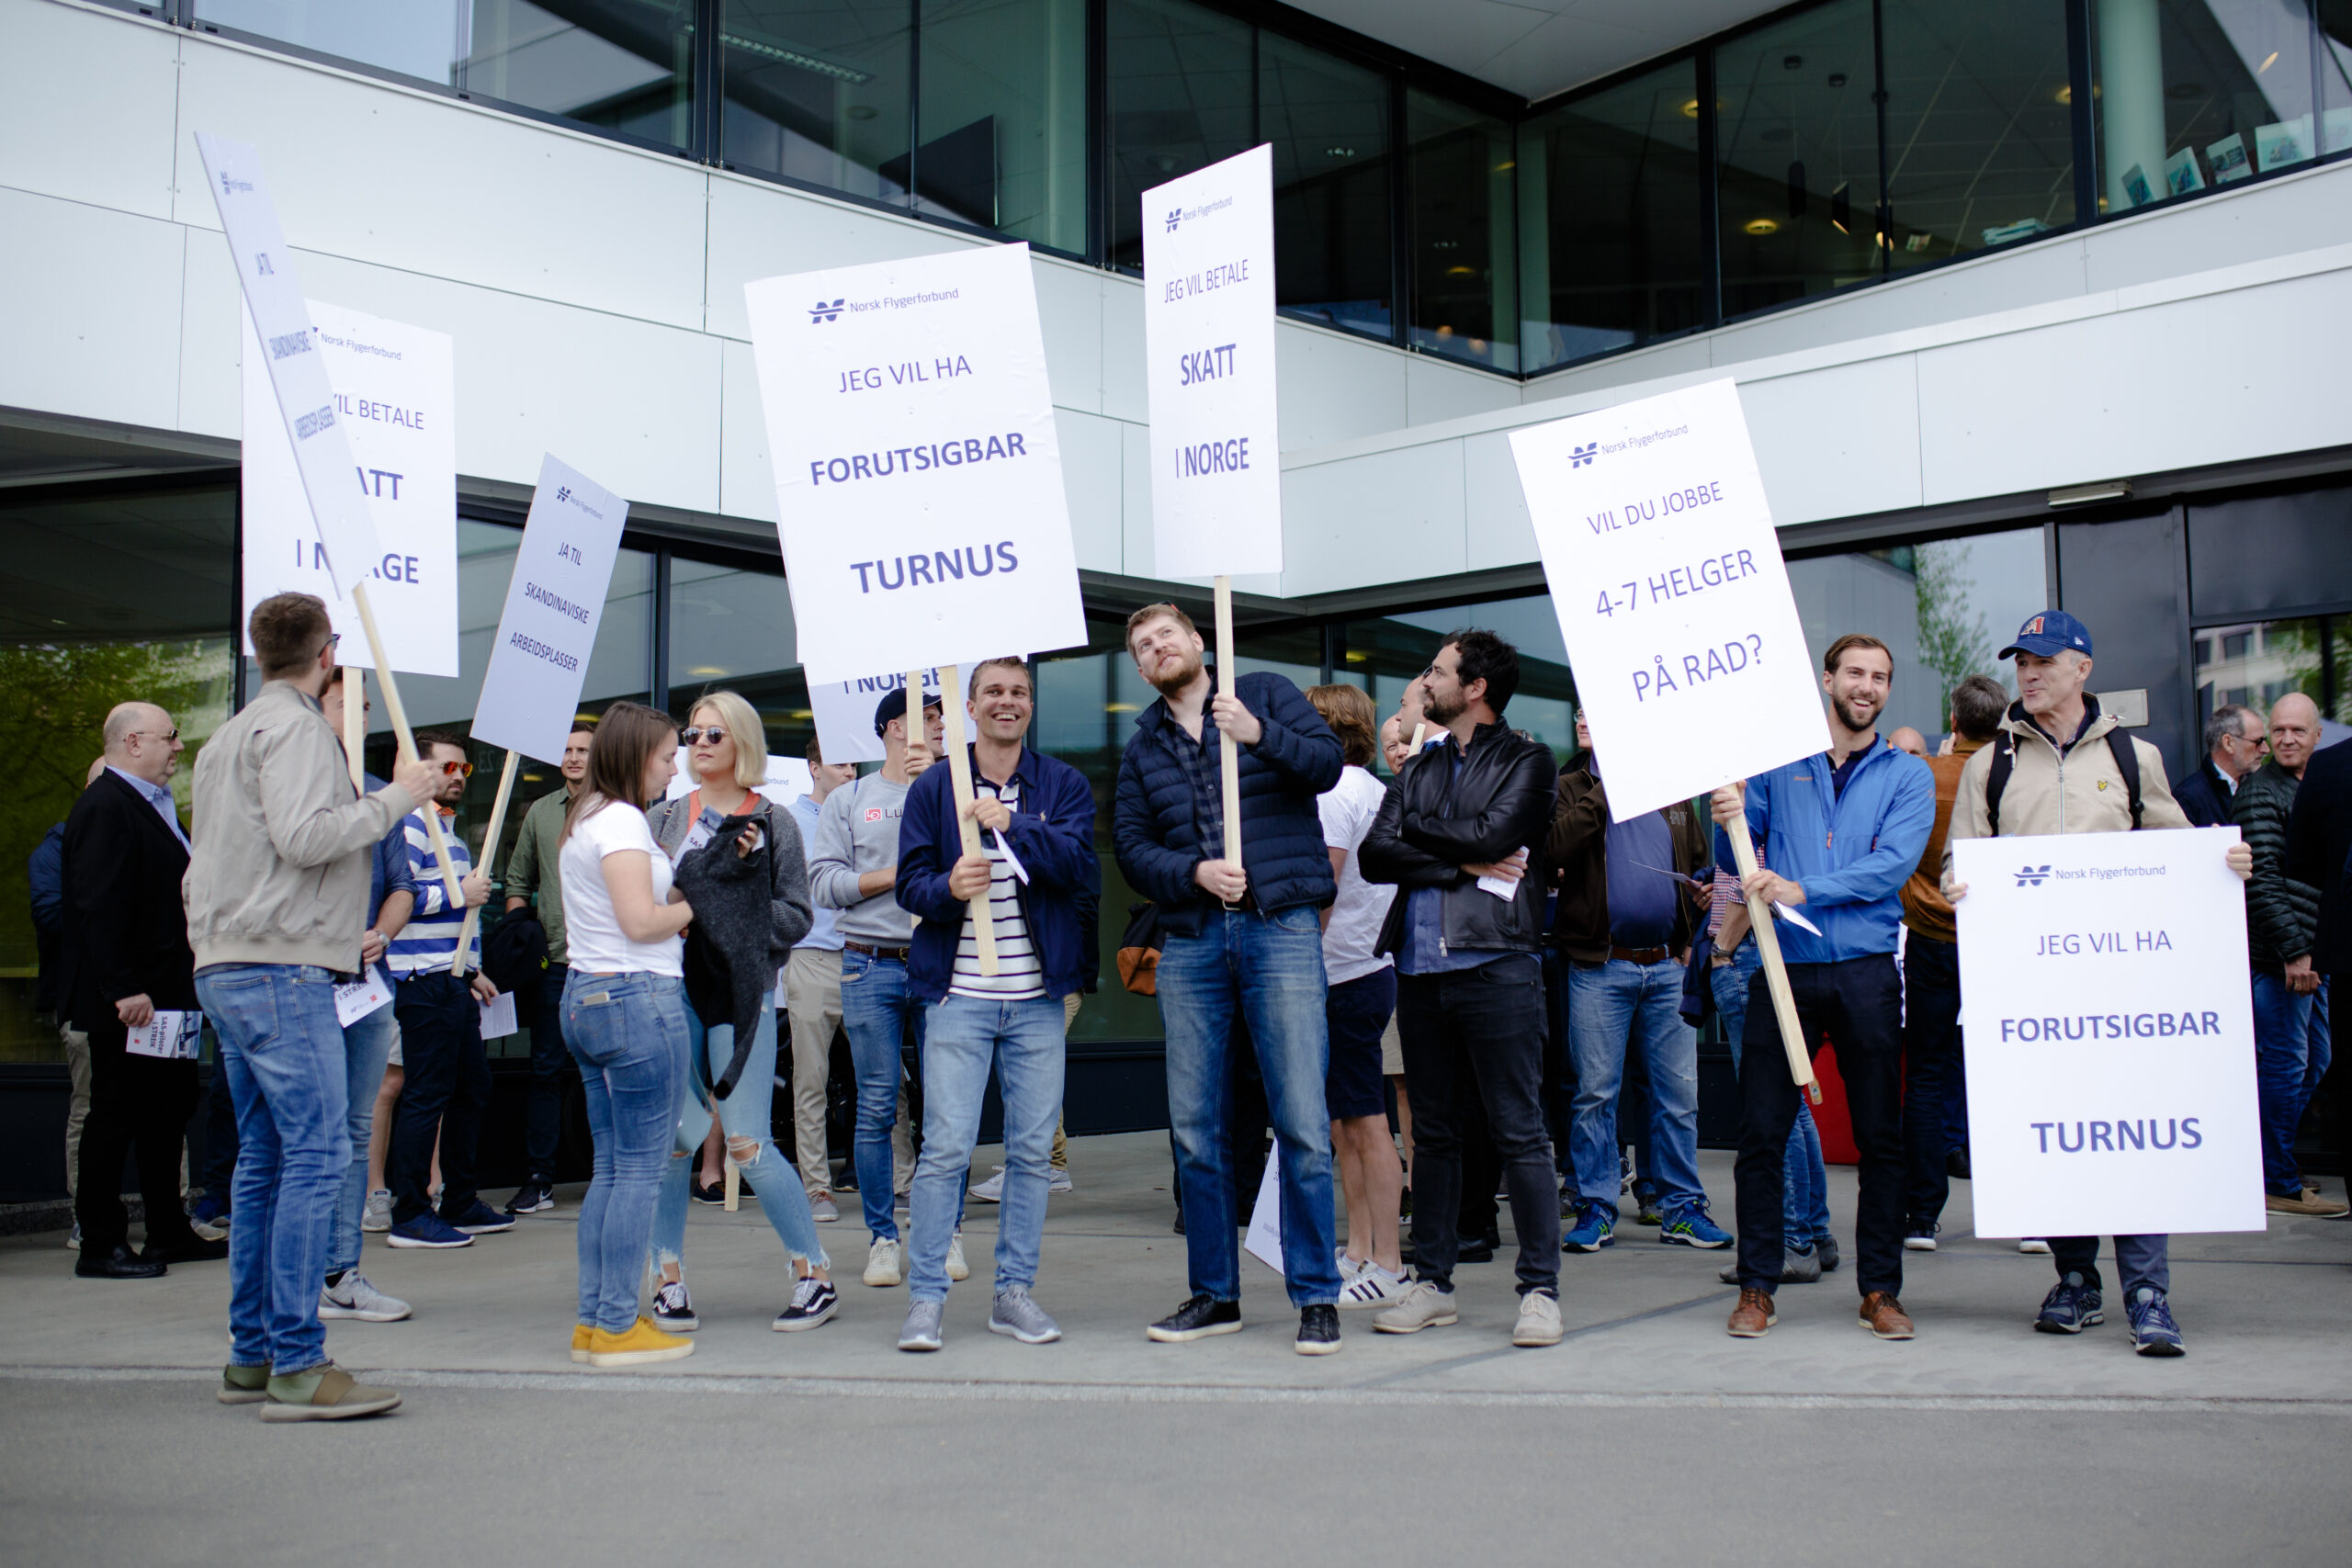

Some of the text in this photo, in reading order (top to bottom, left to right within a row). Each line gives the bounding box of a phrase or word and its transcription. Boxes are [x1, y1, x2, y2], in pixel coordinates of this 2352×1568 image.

[1182, 197, 1232, 221] Norsk Flygerforbund
[850, 288, 958, 312] Norsk Flygerforbund
[1165, 259, 1249, 303] JEG VIL BETALE
[321, 333, 401, 360] Norsk Flygerforbund
[1182, 344, 1236, 386] SKATT
[840, 355, 972, 392] JEG VIL HA
[334, 394, 424, 430] IL BETALE
[1176, 437, 1249, 478] I NORGE
[1602, 424, 1688, 455] Norsk Flygerforbund
[811, 433, 1026, 485] FORUTSIGBAR
[1588, 481, 1723, 535] VIL DU JOBBE
[297, 539, 418, 583] I NGE
[558, 540, 582, 567] JA TIL
[850, 541, 1018, 593] TURNUS
[1597, 550, 1757, 616] 4-7 HELGER
[525, 582, 589, 624] SKANDINAVISKE
[510, 632, 578, 671] ARBEIDSPLASSER
[1633, 634, 1761, 702] PÅ RAD?
[2056, 865, 2165, 880] Norsk Flygerforbund
[2037, 931, 2172, 955] JEG VIL HA
[2001, 1011, 2221, 1042] FORUTSIGBAR
[2030, 1118, 2202, 1153] TURNUS
